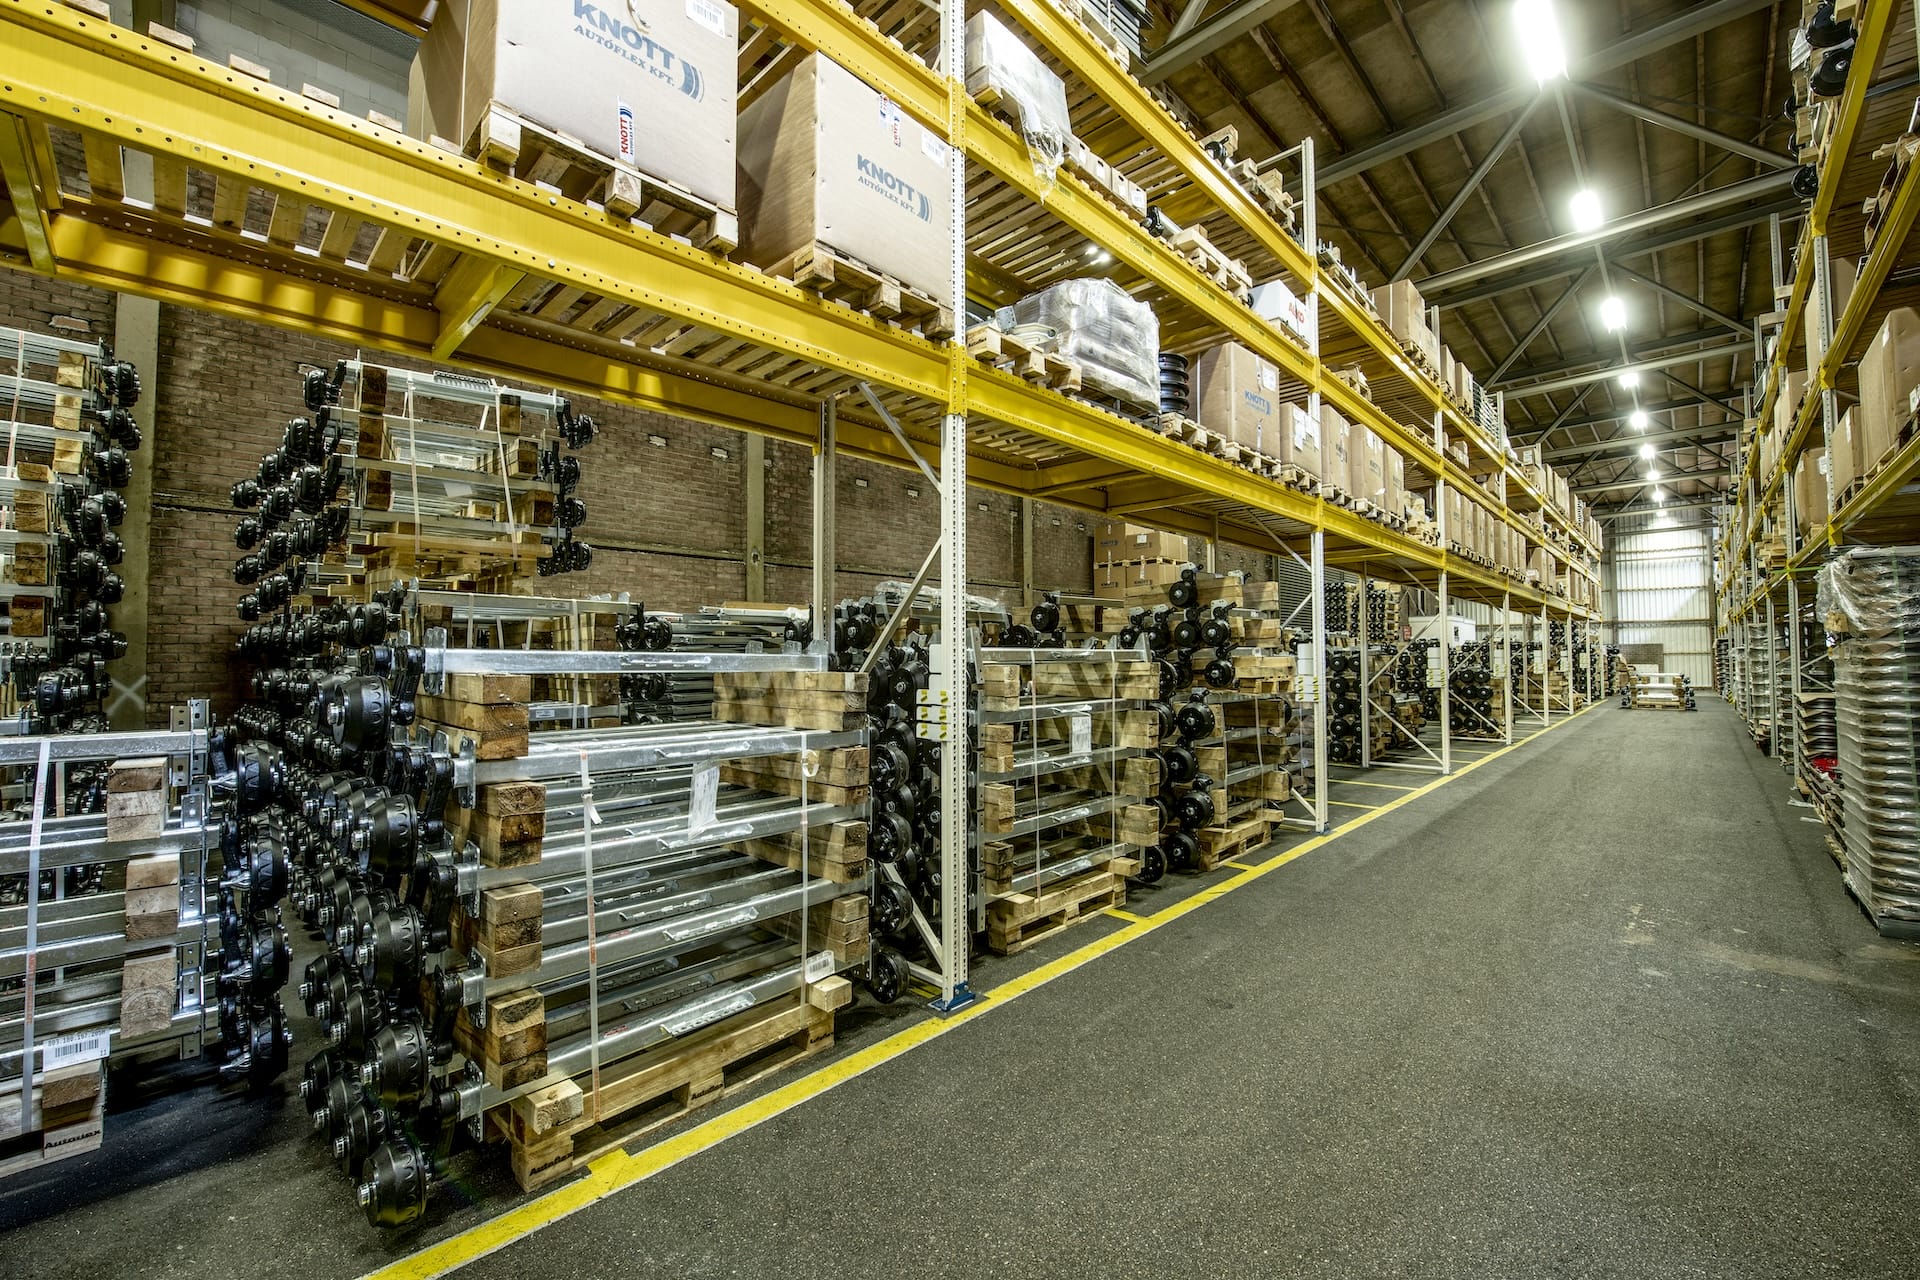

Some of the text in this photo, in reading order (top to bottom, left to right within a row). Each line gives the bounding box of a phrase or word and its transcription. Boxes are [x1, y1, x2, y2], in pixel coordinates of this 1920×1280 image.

[573, 0, 675, 70] KNOTT
[573, 24, 675, 87] AUTÓFLEX KFT.
[619, 116, 629, 154] KNOTT
[857, 153, 915, 202] KNOTT
[858, 175, 899, 204] AUTÓFLEX
[1245, 390, 1266, 408] KNOTT
